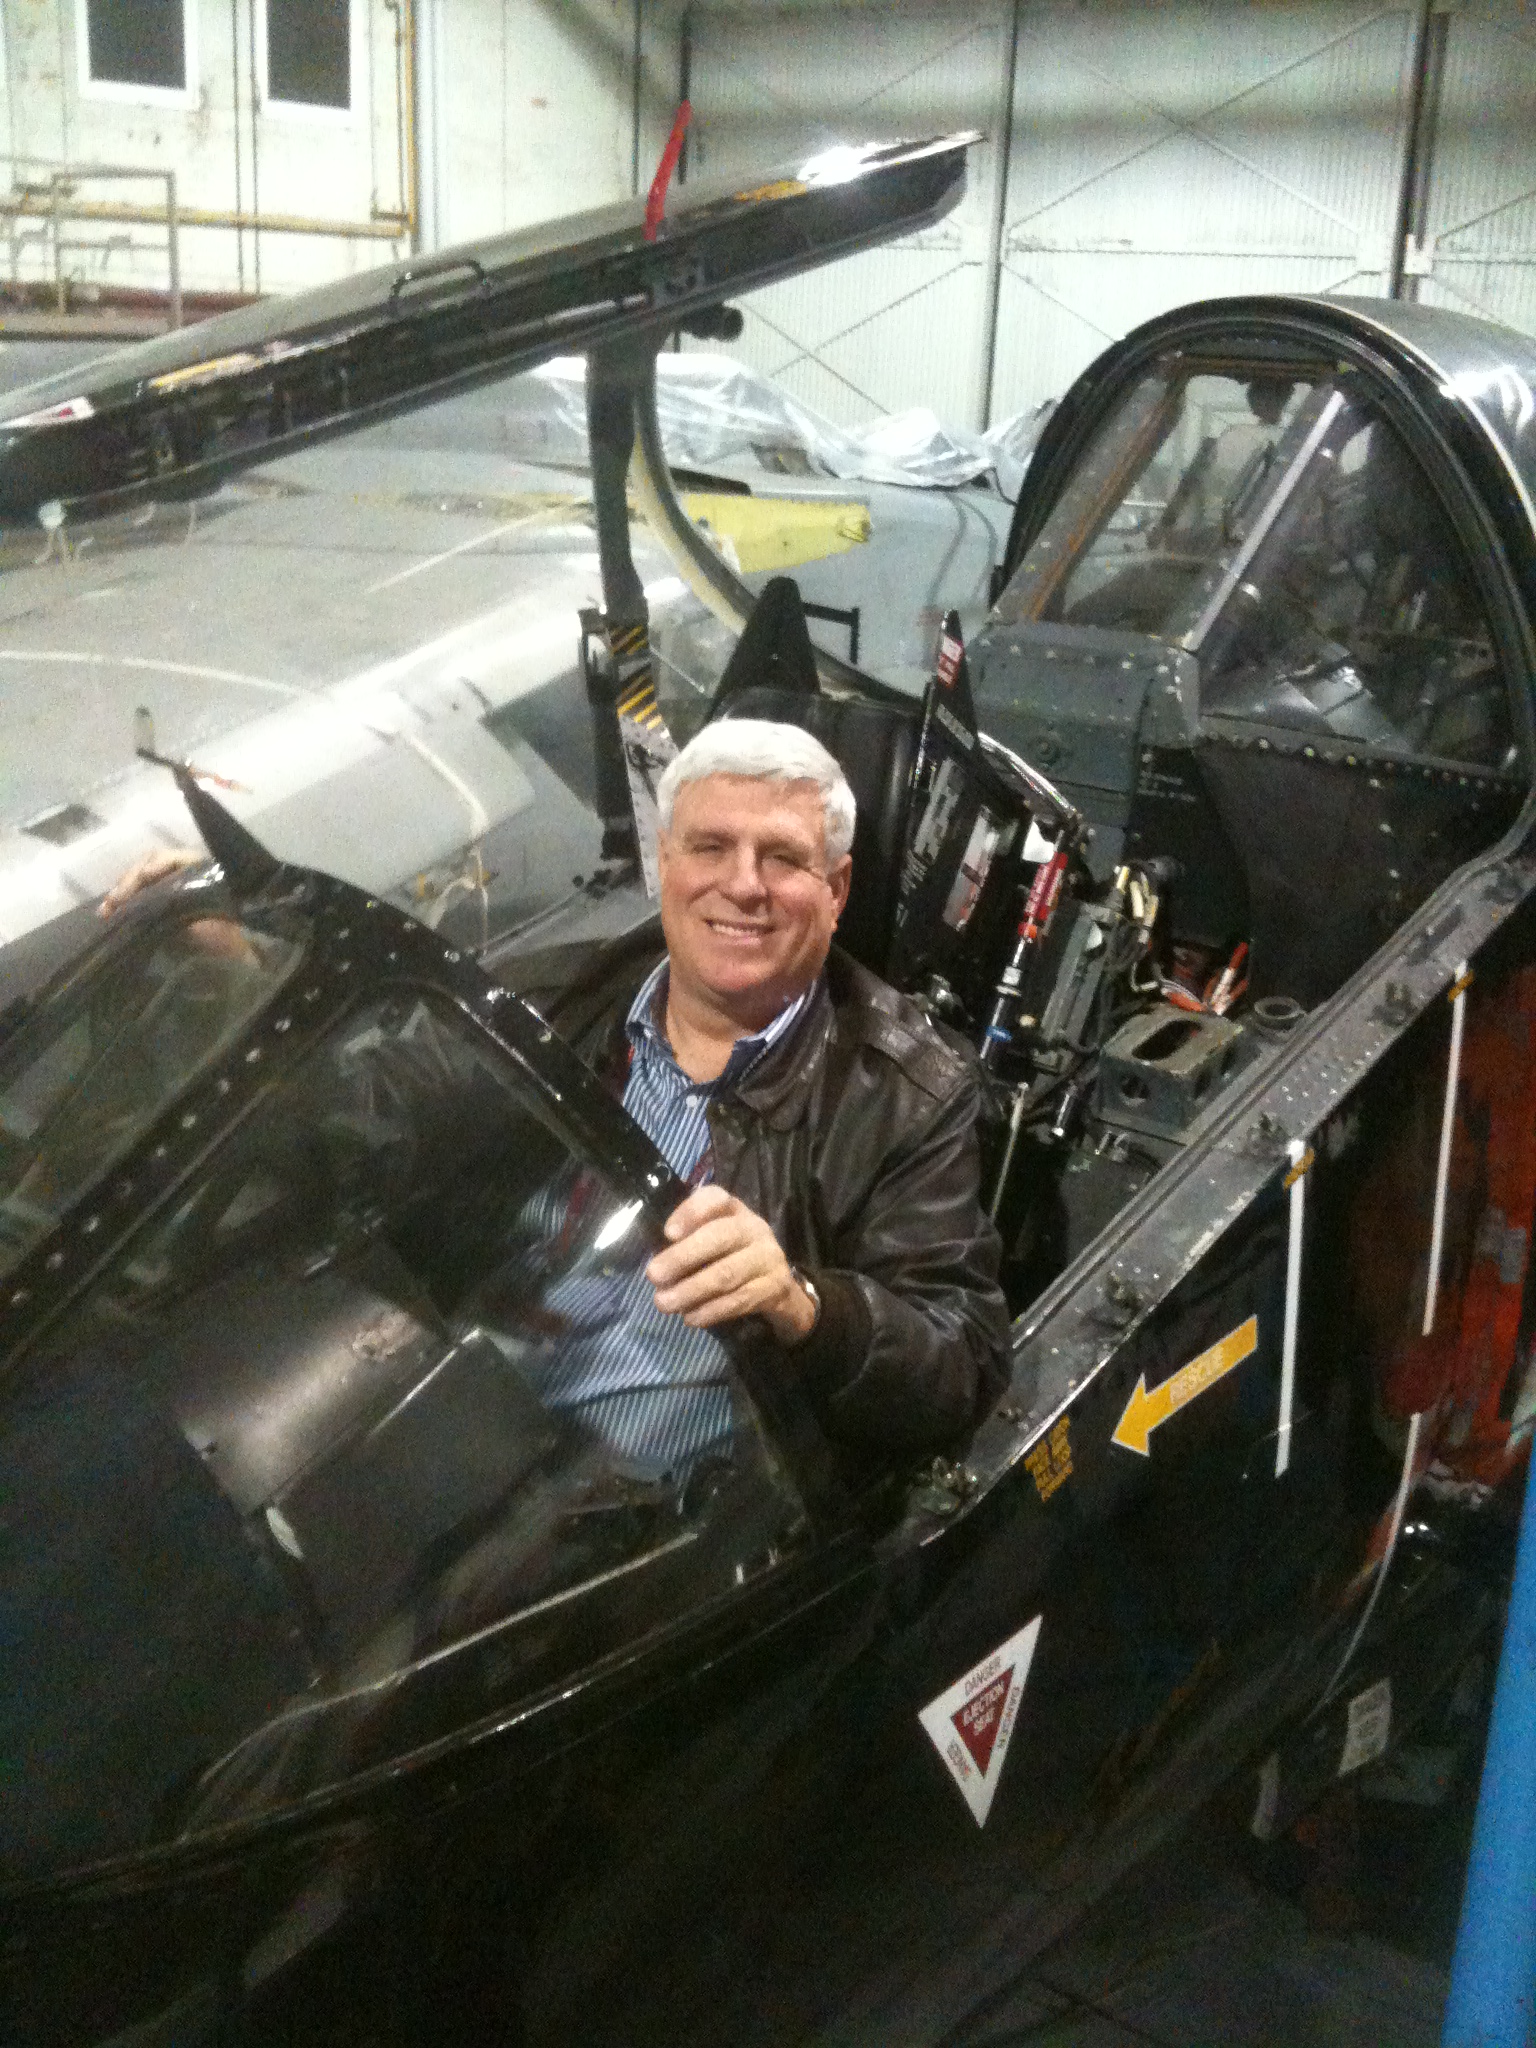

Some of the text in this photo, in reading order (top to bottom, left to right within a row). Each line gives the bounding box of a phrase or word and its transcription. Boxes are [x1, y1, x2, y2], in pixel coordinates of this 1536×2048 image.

[965, 1656, 1002, 1696] DANGER
[963, 1680, 1005, 1727] EJECTION
[973, 1708, 996, 1736] SEAT
